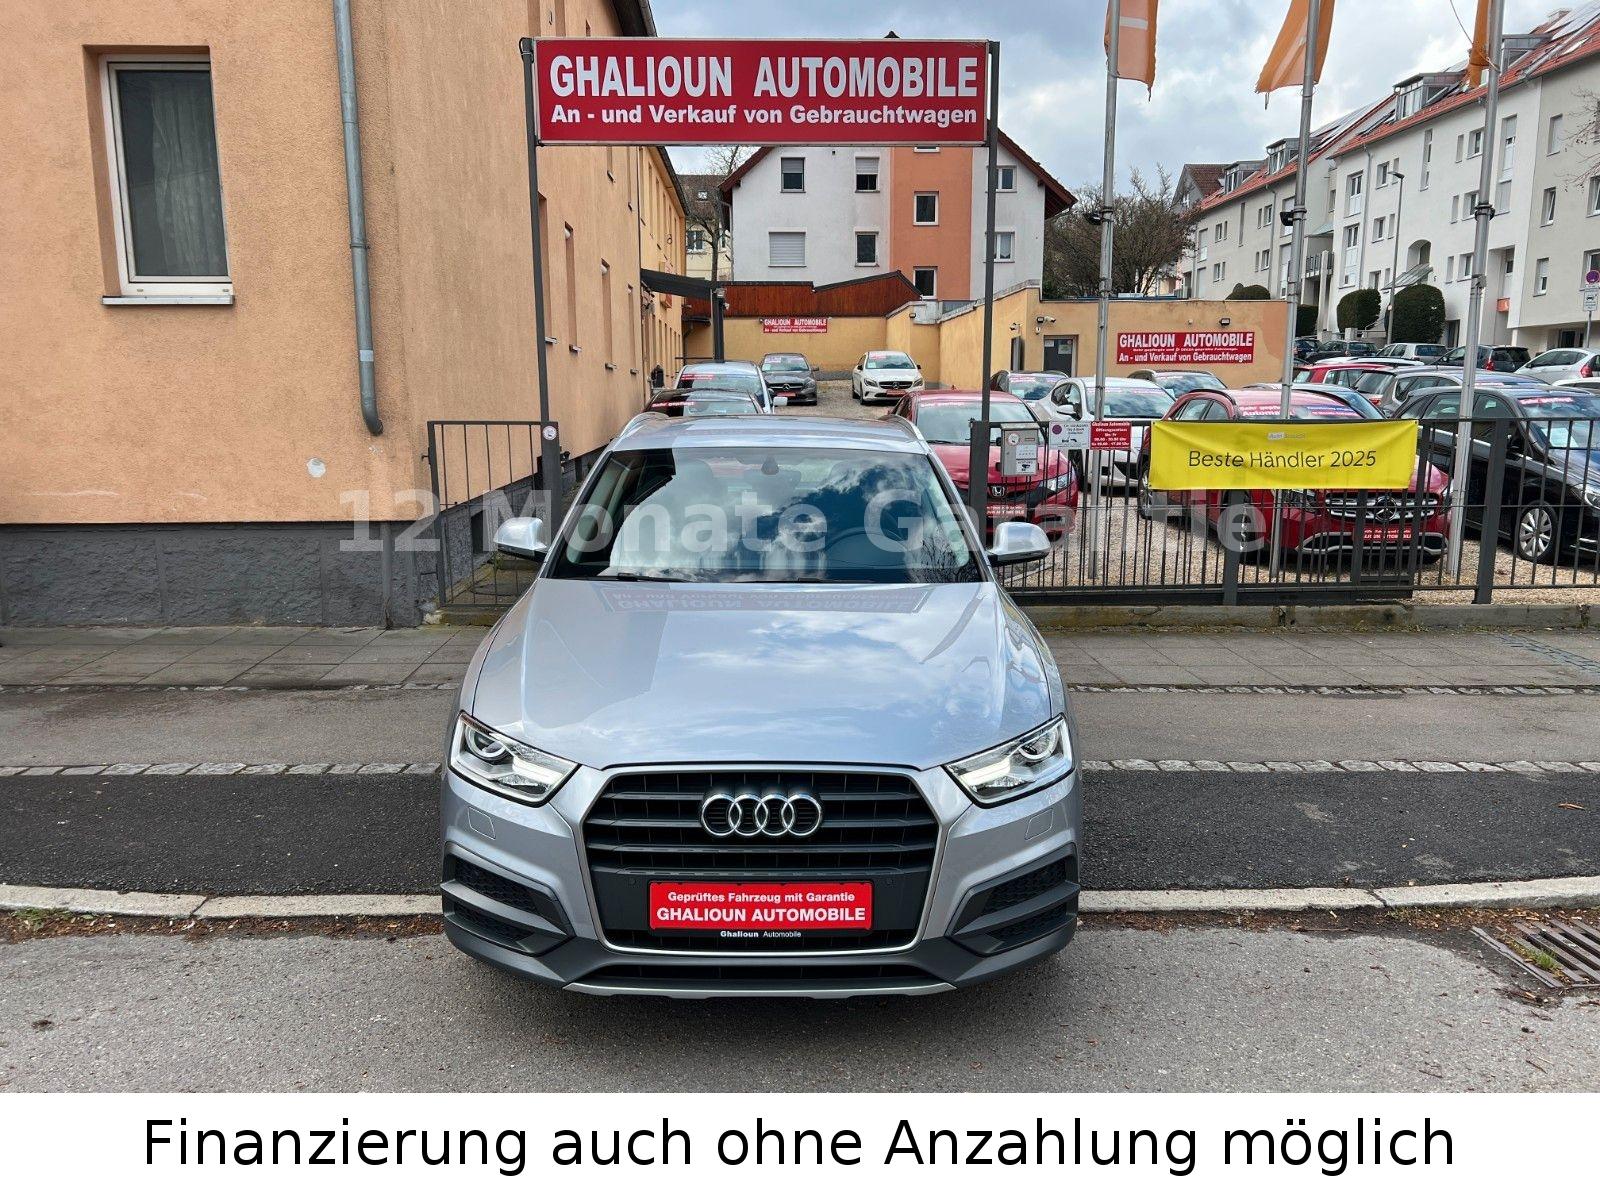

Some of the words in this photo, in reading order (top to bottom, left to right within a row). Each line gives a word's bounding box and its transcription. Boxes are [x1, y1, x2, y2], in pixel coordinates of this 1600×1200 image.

[549, 55, 732, 97] GHALIOUN
[753, 56, 978, 98] AUTOMOBILE
[551, 105, 581, 123] An
[601, 105, 642, 123] und
[648, 104, 737, 124] Verkauf
[743, 109, 783, 123] von
[789, 104, 977, 128] Gebrauchtwagen
[1119, 334, 1176, 348] GHALIOUN
[1183, 333, 1253, 347] AUTOMOBILE
[1118, 352, 1129, 361] An
[1135, 352, 1148, 362] und
[1149, 351, 1178, 362] Verkauf
[1178, 353, 1192, 361] von
[1192, 351, 1252, 364] Gebrauchtwagen
[1188, 450, 1244, 468] Beste
[1250, 451, 1325, 468] Händler
[1330, 450, 1377, 468] 2025
[667, 892, 726, 904] Geprüftes
[728, 892, 781, 904] Fahrzeug
[784, 892, 803, 902] mit
[805, 892, 855, 902] Garantie
[656, 907, 746, 922] GHALIOUN
[751, 907, 866, 922] AUTOMOBILE
[720, 930, 759, 938] Ghalioun
[763, 930, 802, 938] Automobile
